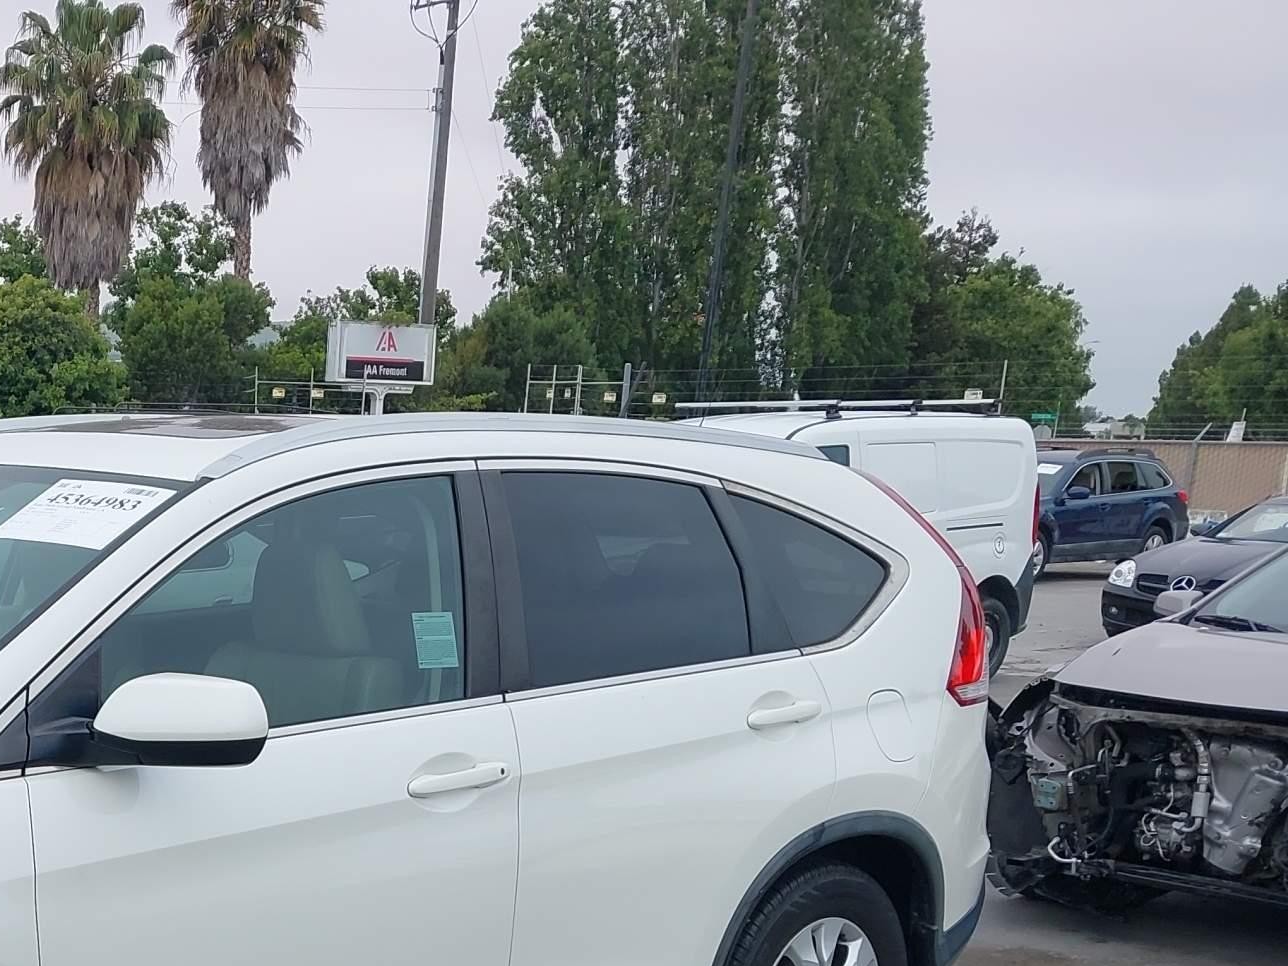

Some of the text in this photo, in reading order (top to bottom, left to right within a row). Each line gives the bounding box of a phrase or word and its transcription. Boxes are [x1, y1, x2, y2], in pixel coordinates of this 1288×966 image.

[364, 364, 407, 377] IAA Fremont
[47, 492, 142, 511] 45364983
